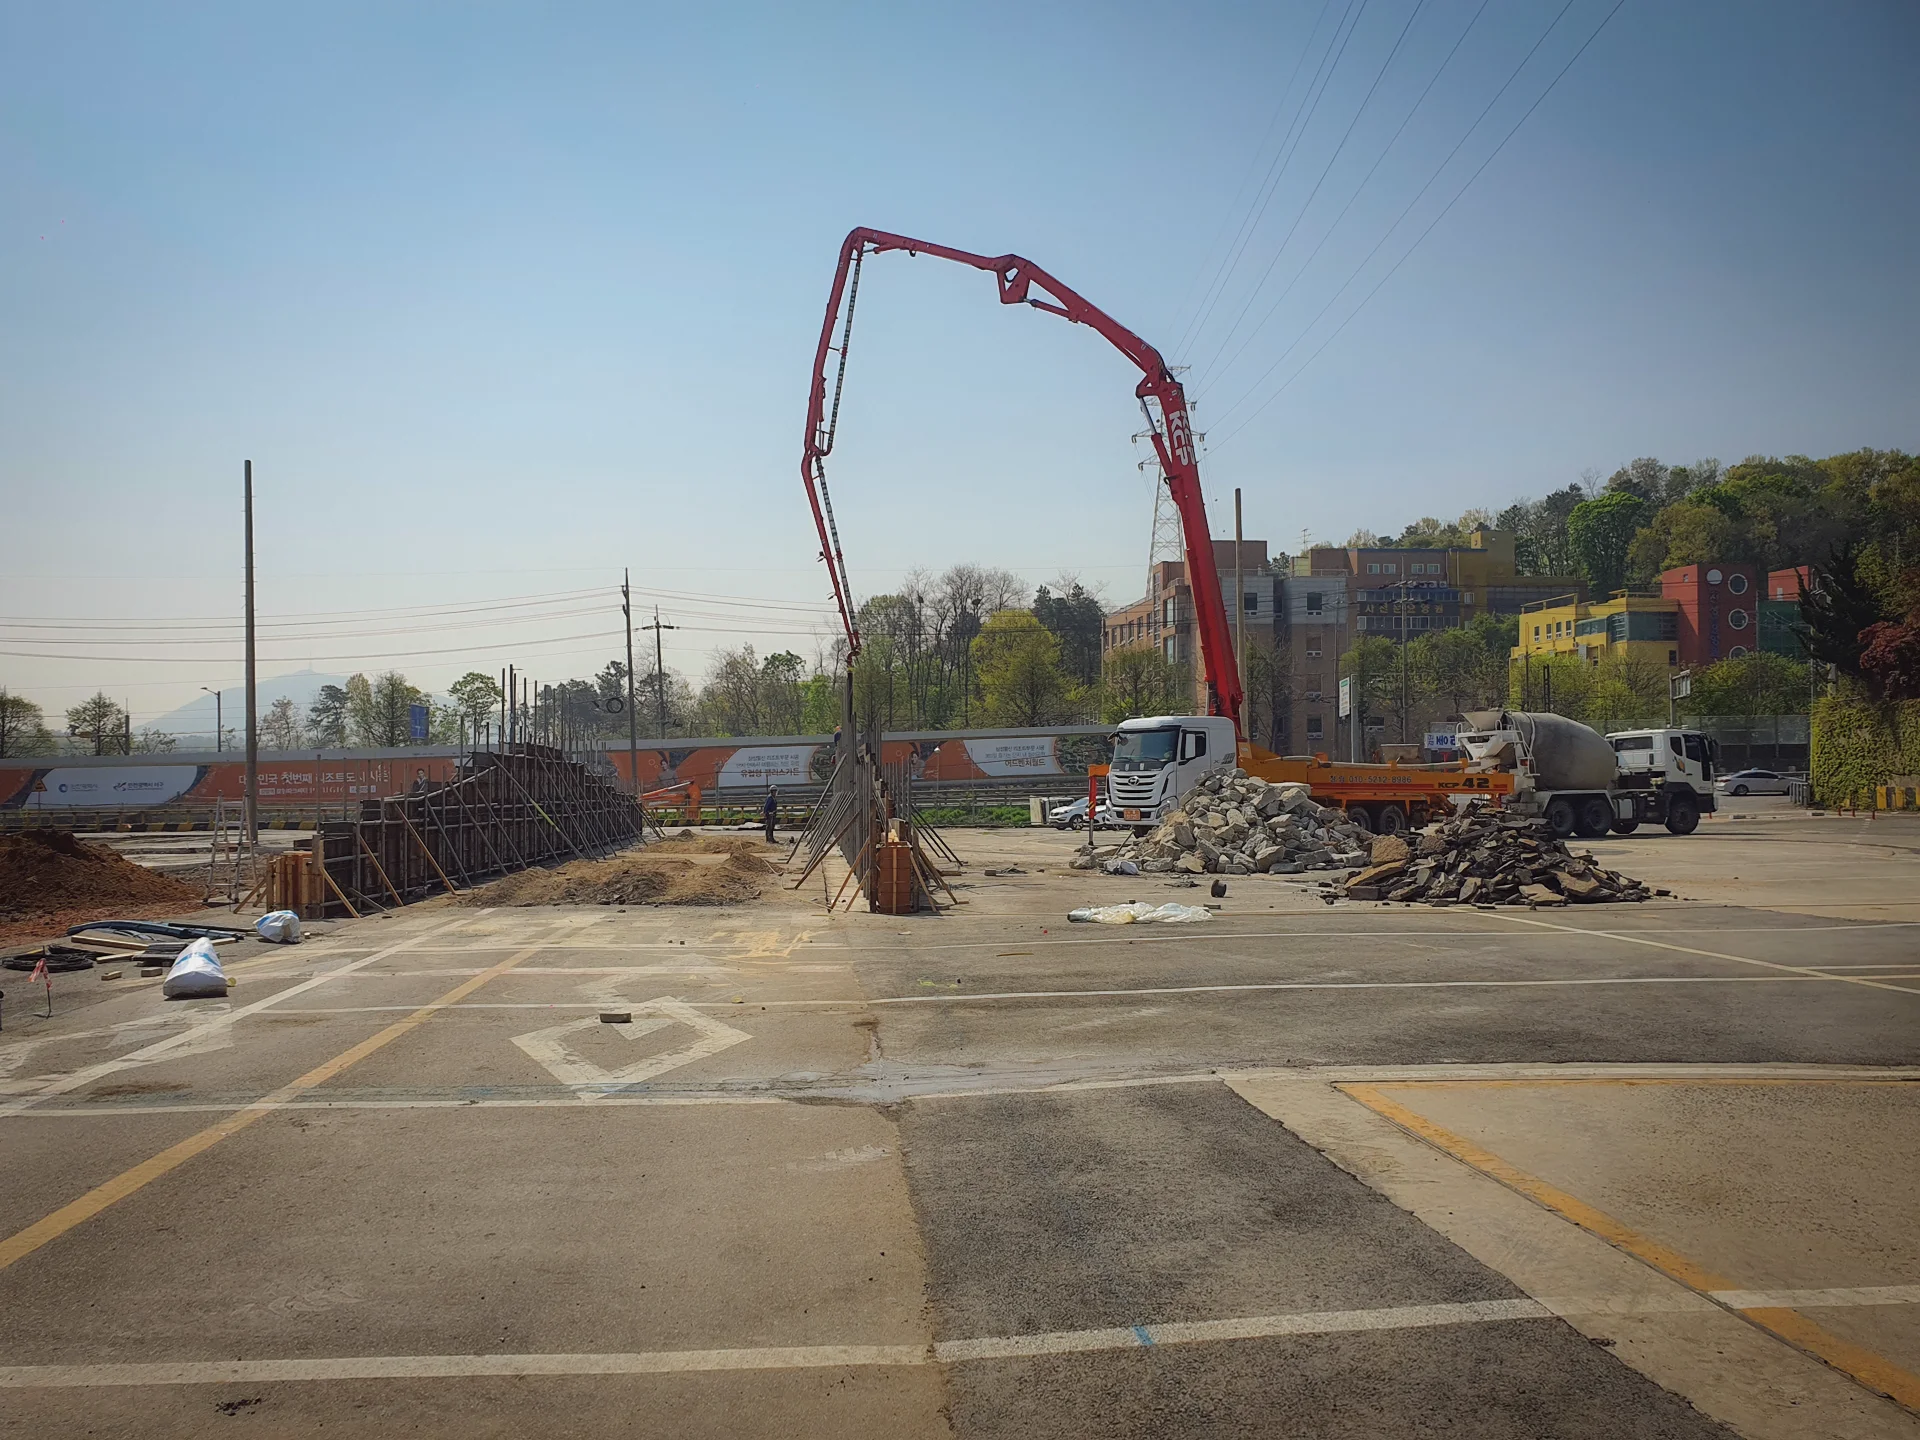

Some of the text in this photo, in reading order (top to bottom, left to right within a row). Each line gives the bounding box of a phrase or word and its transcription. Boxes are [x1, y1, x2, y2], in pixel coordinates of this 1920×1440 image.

[1169, 411, 1188, 465] KCP
[239, 772, 278, 785] 대민국
[281, 771, 313, 784] 첫번째
[1348, 775, 1412, 784] 010-5212-8986
[1462, 777, 1490, 789] 42
